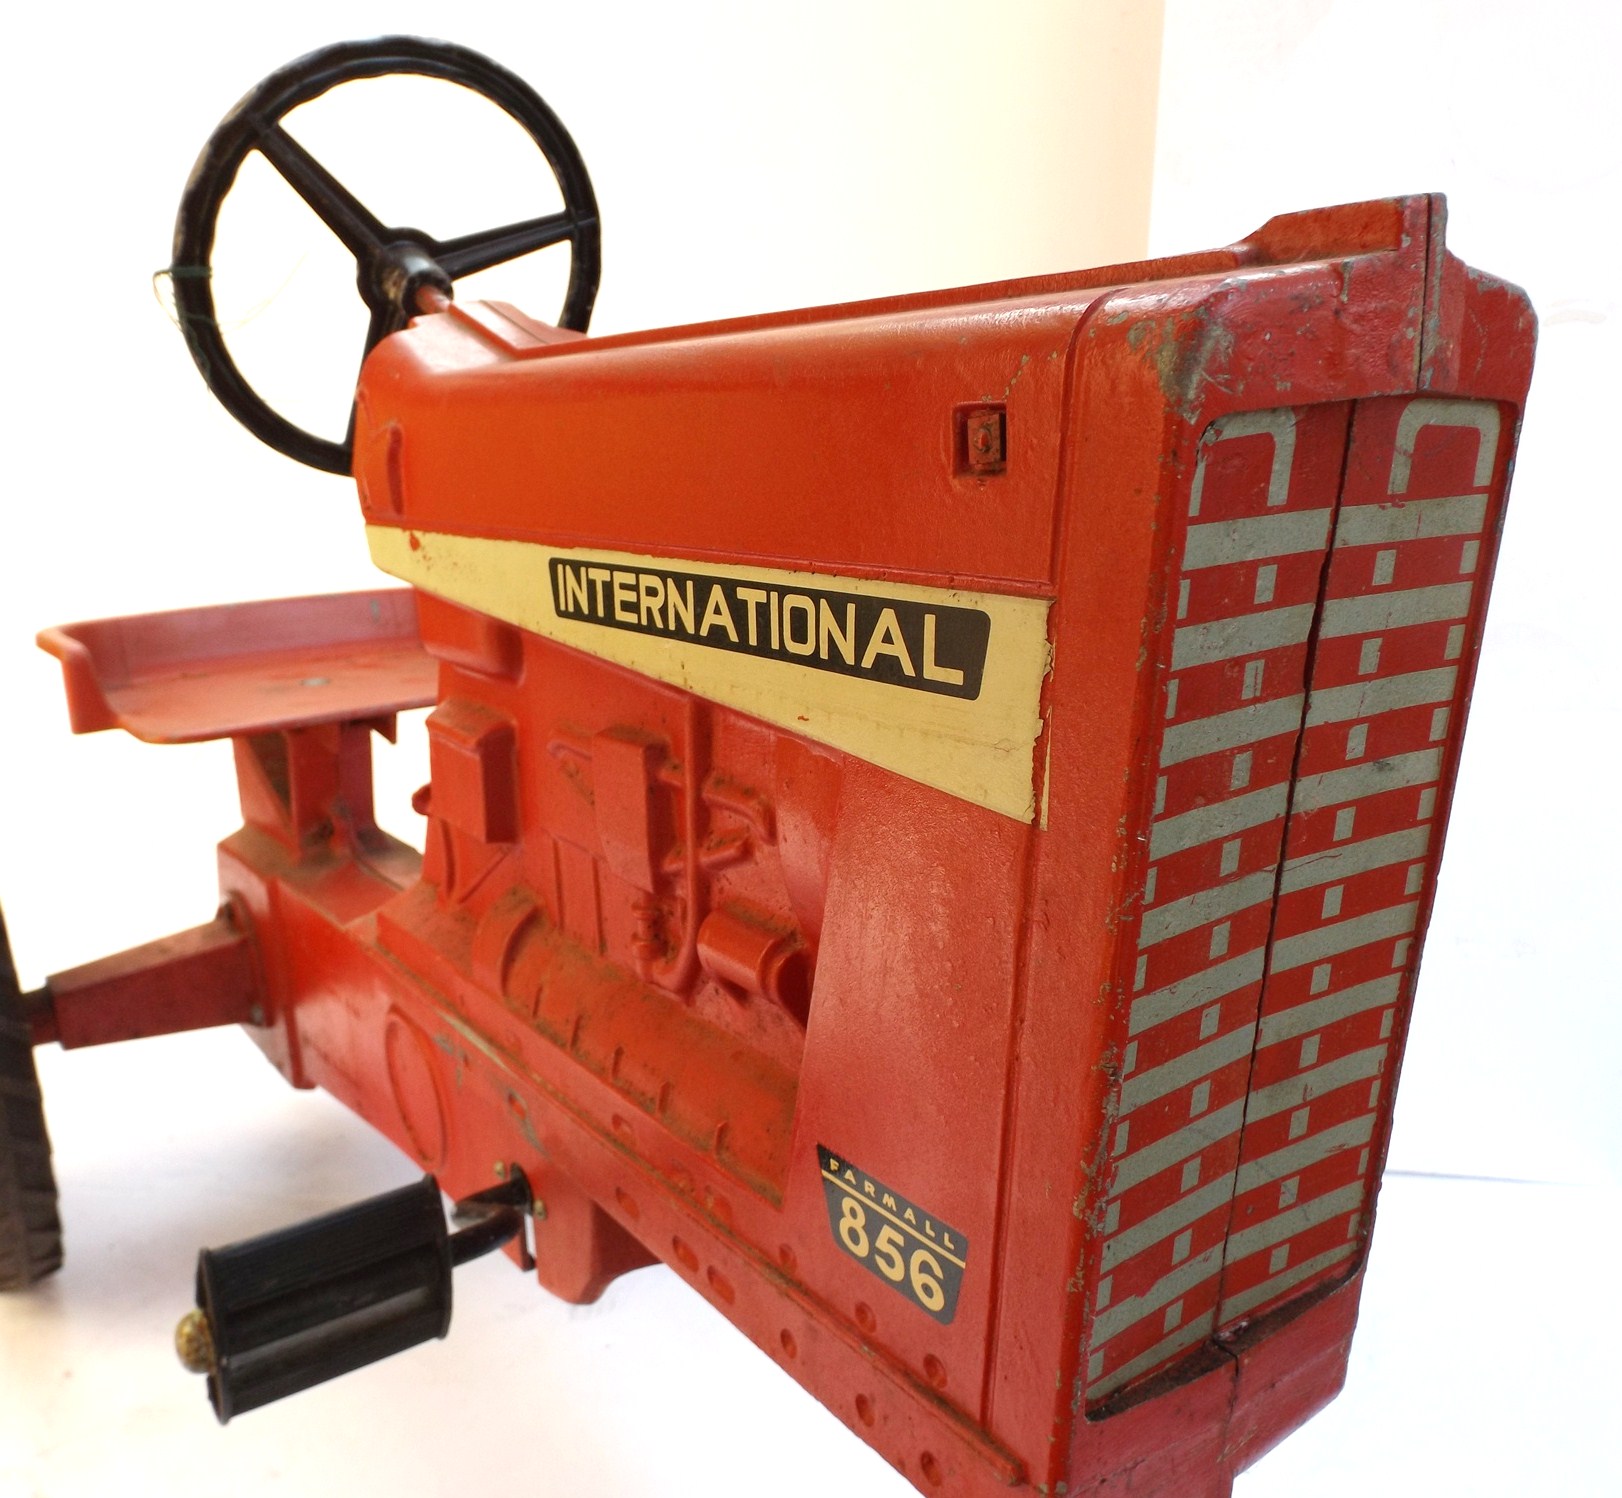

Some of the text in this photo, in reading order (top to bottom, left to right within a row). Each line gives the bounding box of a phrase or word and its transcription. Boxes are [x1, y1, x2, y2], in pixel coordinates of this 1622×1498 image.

[556, 564, 965, 686] INTERNATIONAL
[829, 1158, 955, 1250] FARMALL
[839, 1196, 945, 1312] 856
